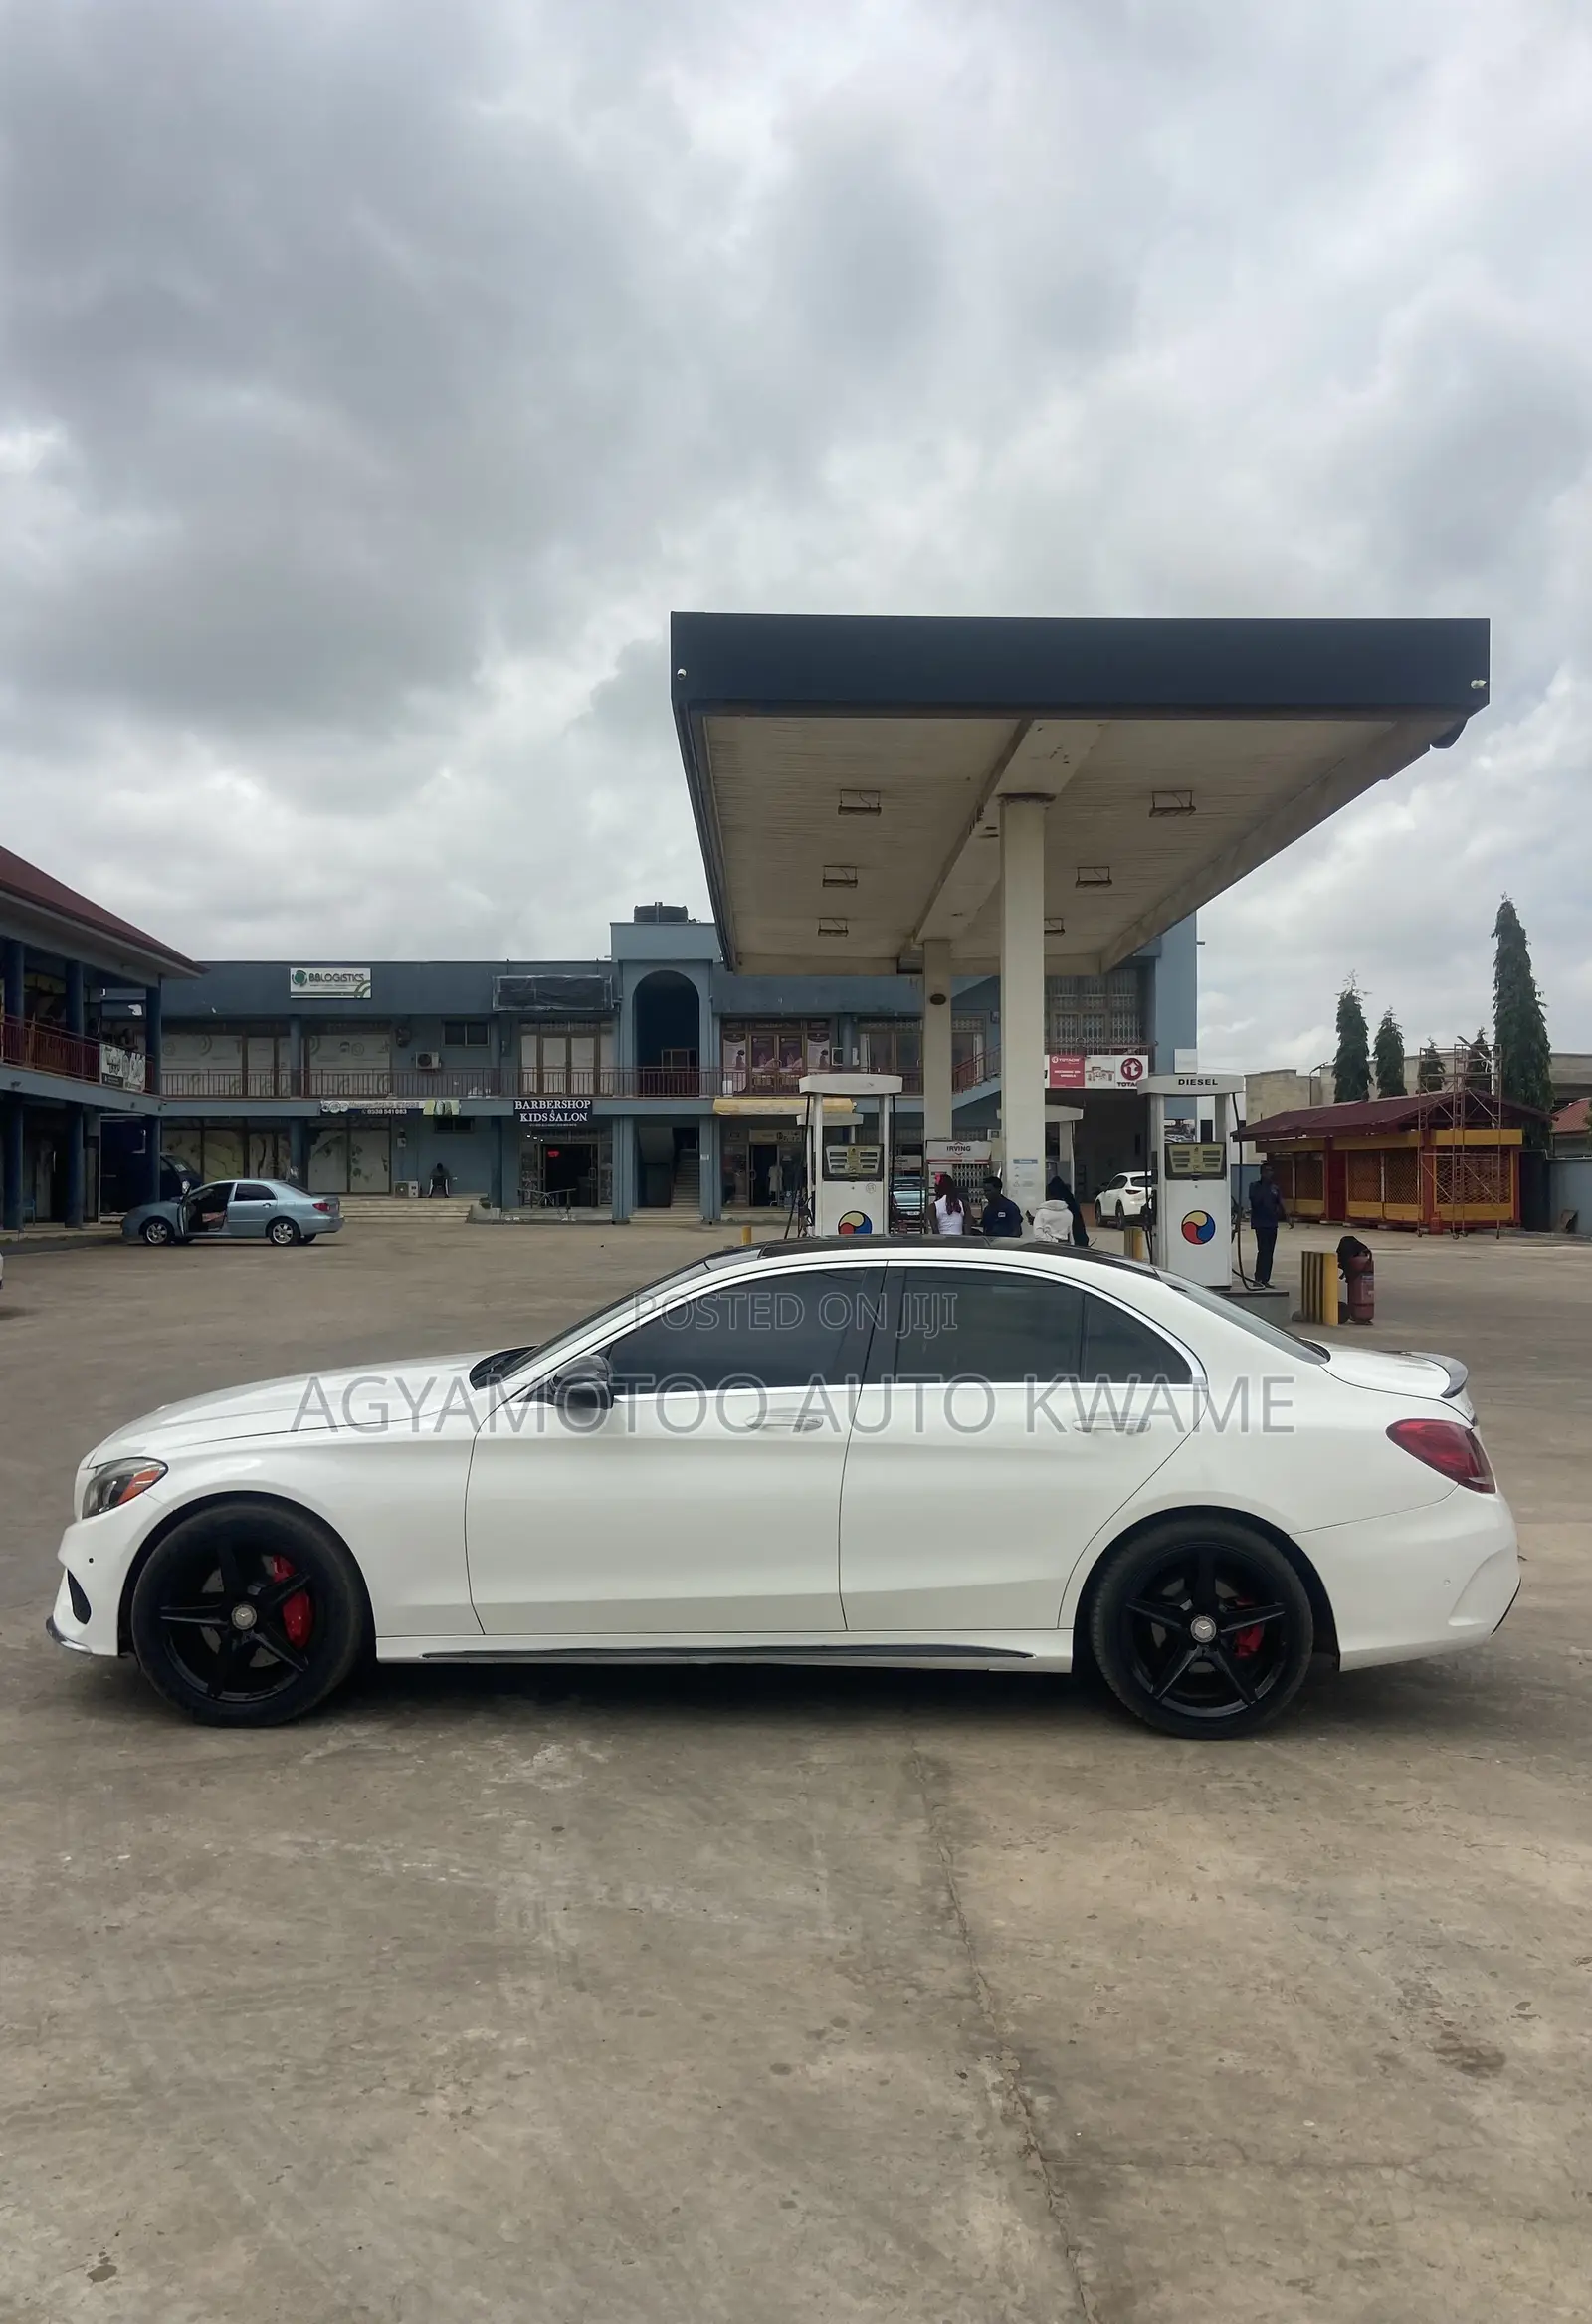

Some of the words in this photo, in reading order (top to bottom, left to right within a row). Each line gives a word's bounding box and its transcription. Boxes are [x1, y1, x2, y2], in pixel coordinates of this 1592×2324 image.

[514, 1099, 591, 1110] BARBERSHOP
[519, 1112, 548, 1122] KIDS
[549, 1112, 588, 1122] SALON
